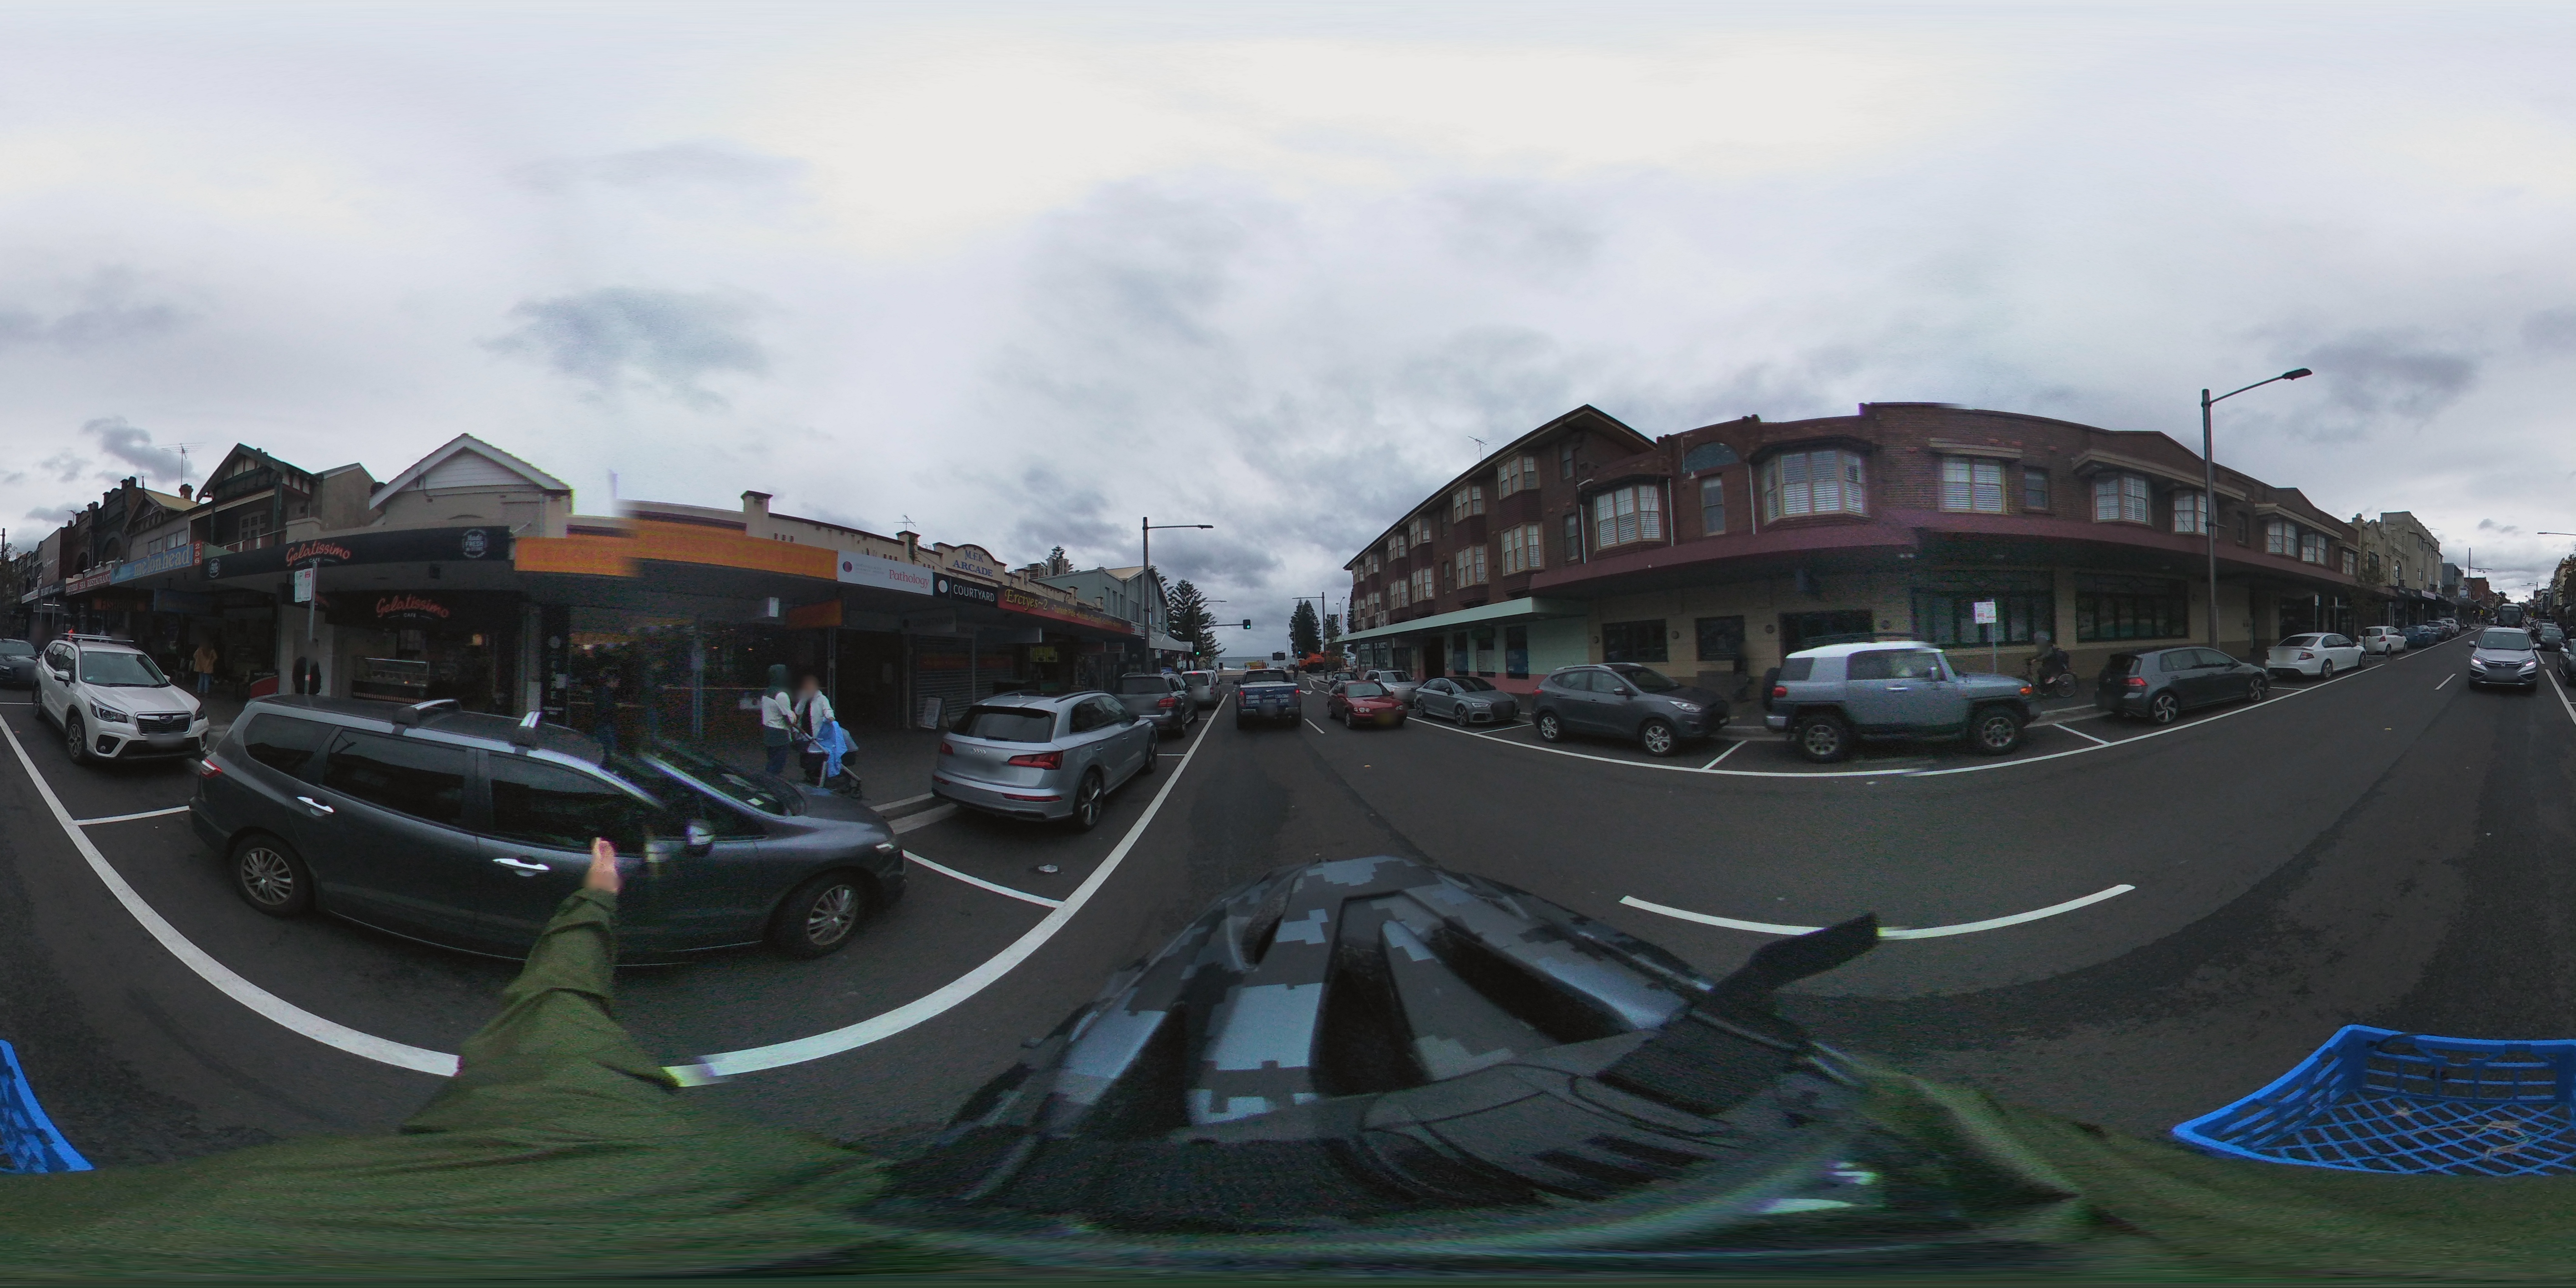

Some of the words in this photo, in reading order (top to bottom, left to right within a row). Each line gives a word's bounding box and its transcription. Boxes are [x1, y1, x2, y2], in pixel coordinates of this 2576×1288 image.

[133, 543, 190, 576] melonhead
[286, 540, 351, 567] Gelatissimo
[953, 560, 993, 577] ARCADE
[86, 573, 111, 588] RESTAURANT
[889, 569, 930, 588] Pathology
[953, 584, 995, 602] COURTYARD
[376, 594, 450, 618] Gelatissimo
